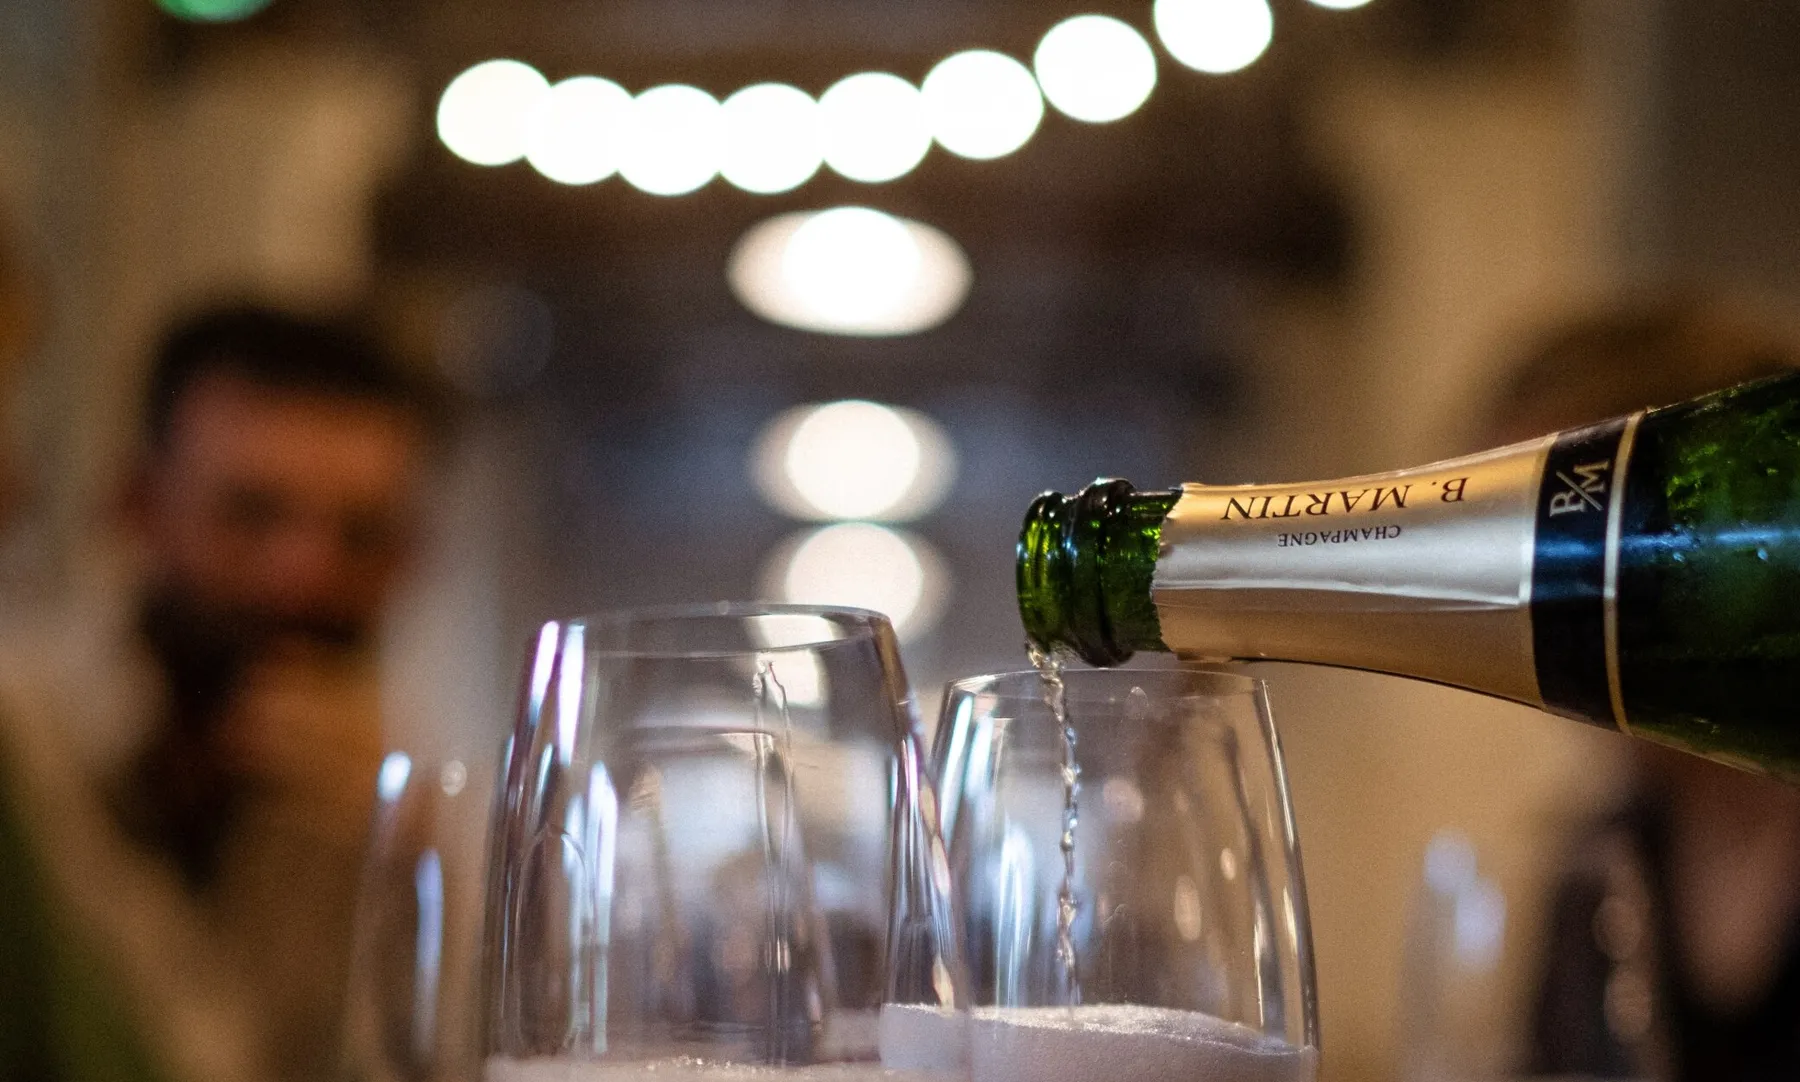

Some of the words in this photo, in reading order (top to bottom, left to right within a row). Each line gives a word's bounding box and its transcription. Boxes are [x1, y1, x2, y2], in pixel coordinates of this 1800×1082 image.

[1221, 484, 1410, 520] MARTIN
[1432, 477, 1470, 503] B.
[1278, 524, 1401, 548] CHAMPAGNE
